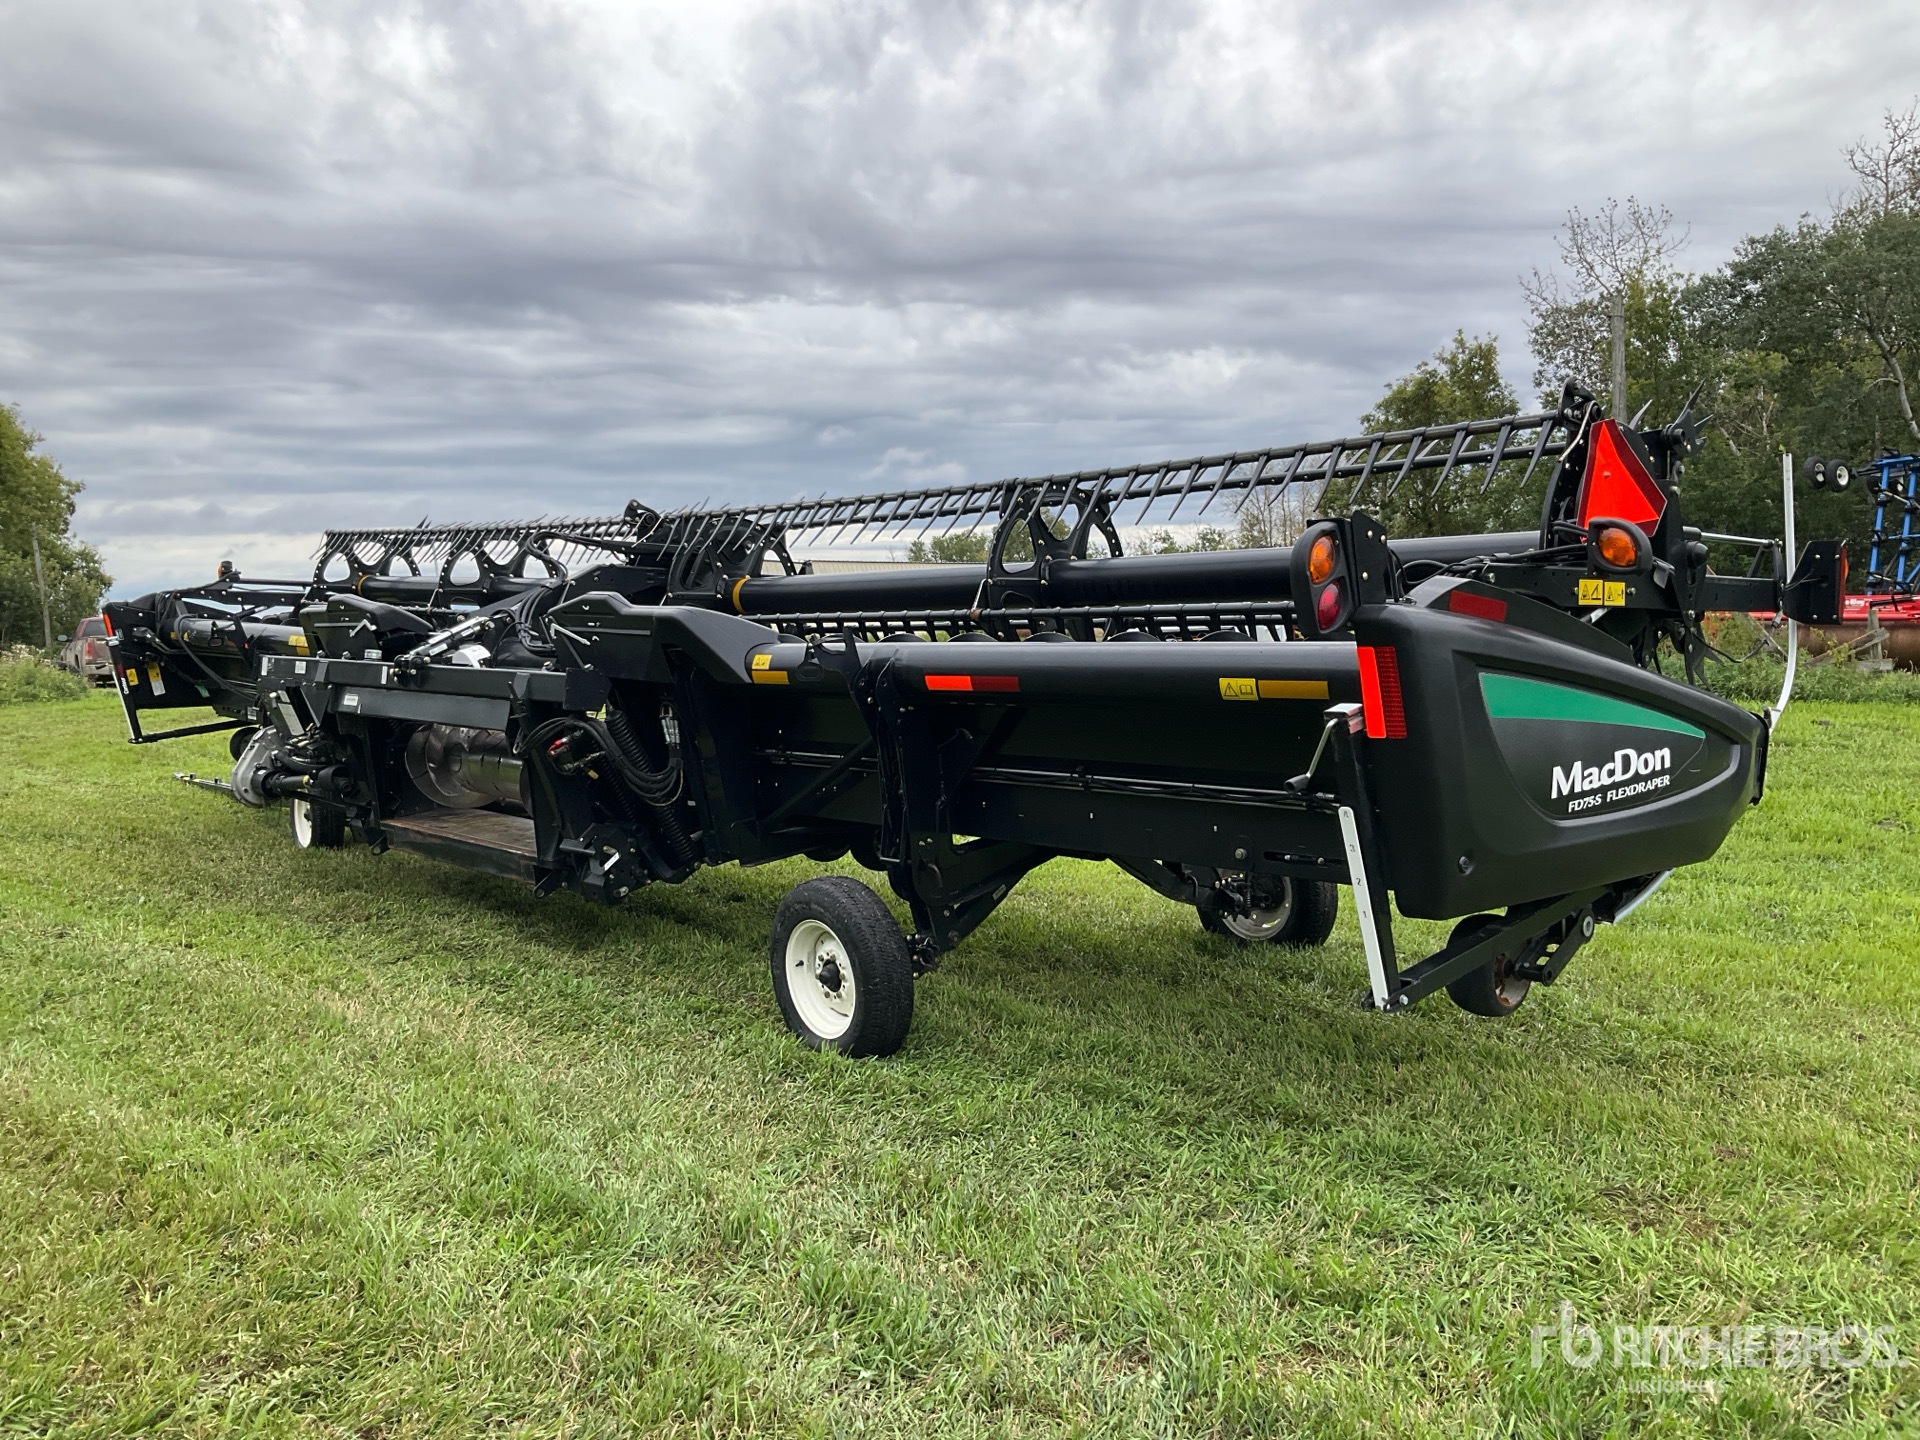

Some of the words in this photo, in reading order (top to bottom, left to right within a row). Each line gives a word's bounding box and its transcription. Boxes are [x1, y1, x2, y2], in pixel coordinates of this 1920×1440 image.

[1551, 747, 1671, 799] MacDon
[1606, 774, 1671, 802] FLEXDRAPER
[1355, 877, 1361, 886] 2
